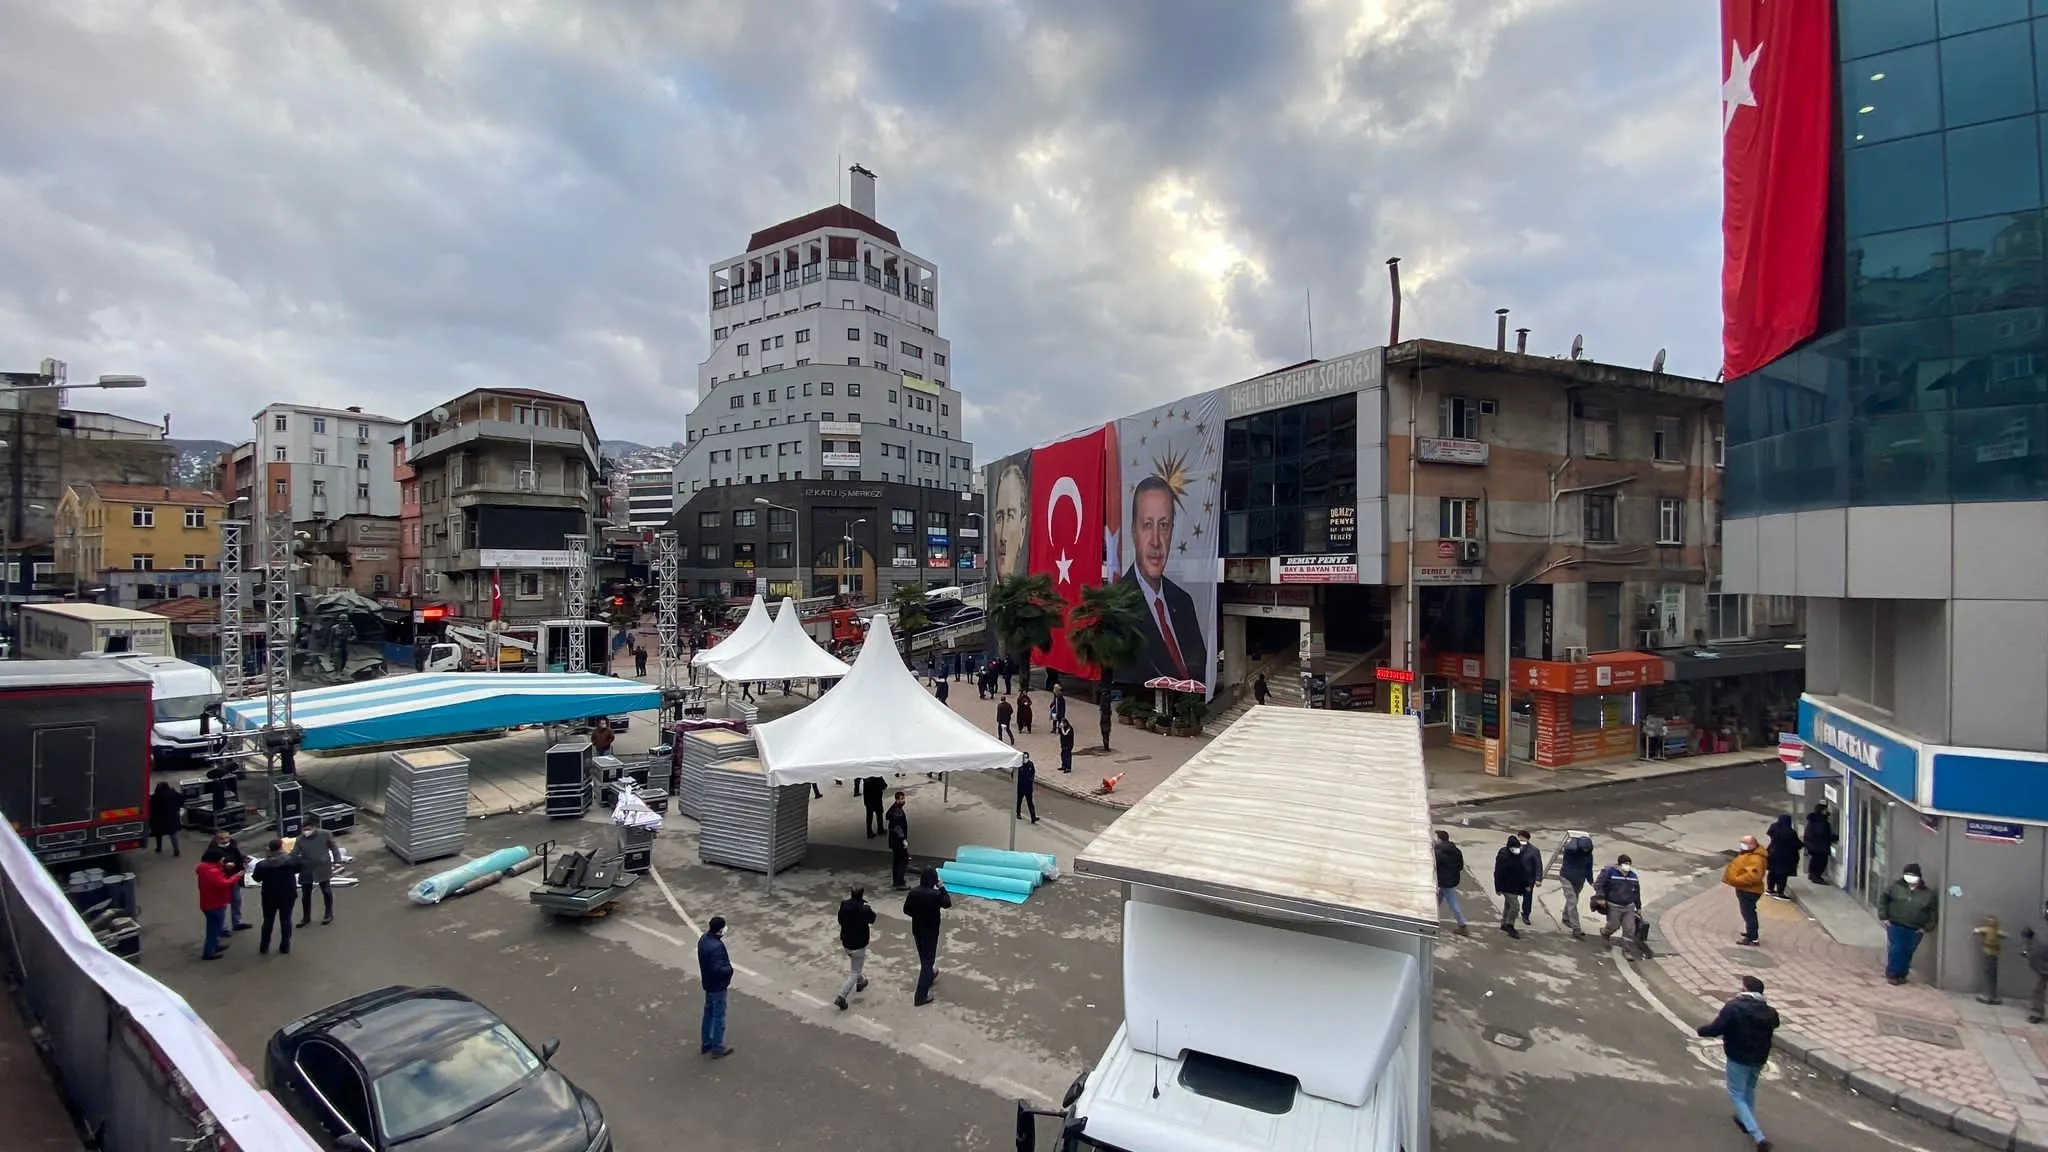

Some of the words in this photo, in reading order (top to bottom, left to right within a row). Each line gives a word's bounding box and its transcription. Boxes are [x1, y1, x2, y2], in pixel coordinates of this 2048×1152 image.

[1330, 507, 1354, 518] DEMET
[1330, 518, 1355, 526] PENYE
[1286, 556, 1317, 565] DEMET
[1317, 556, 1349, 564] PENYE
